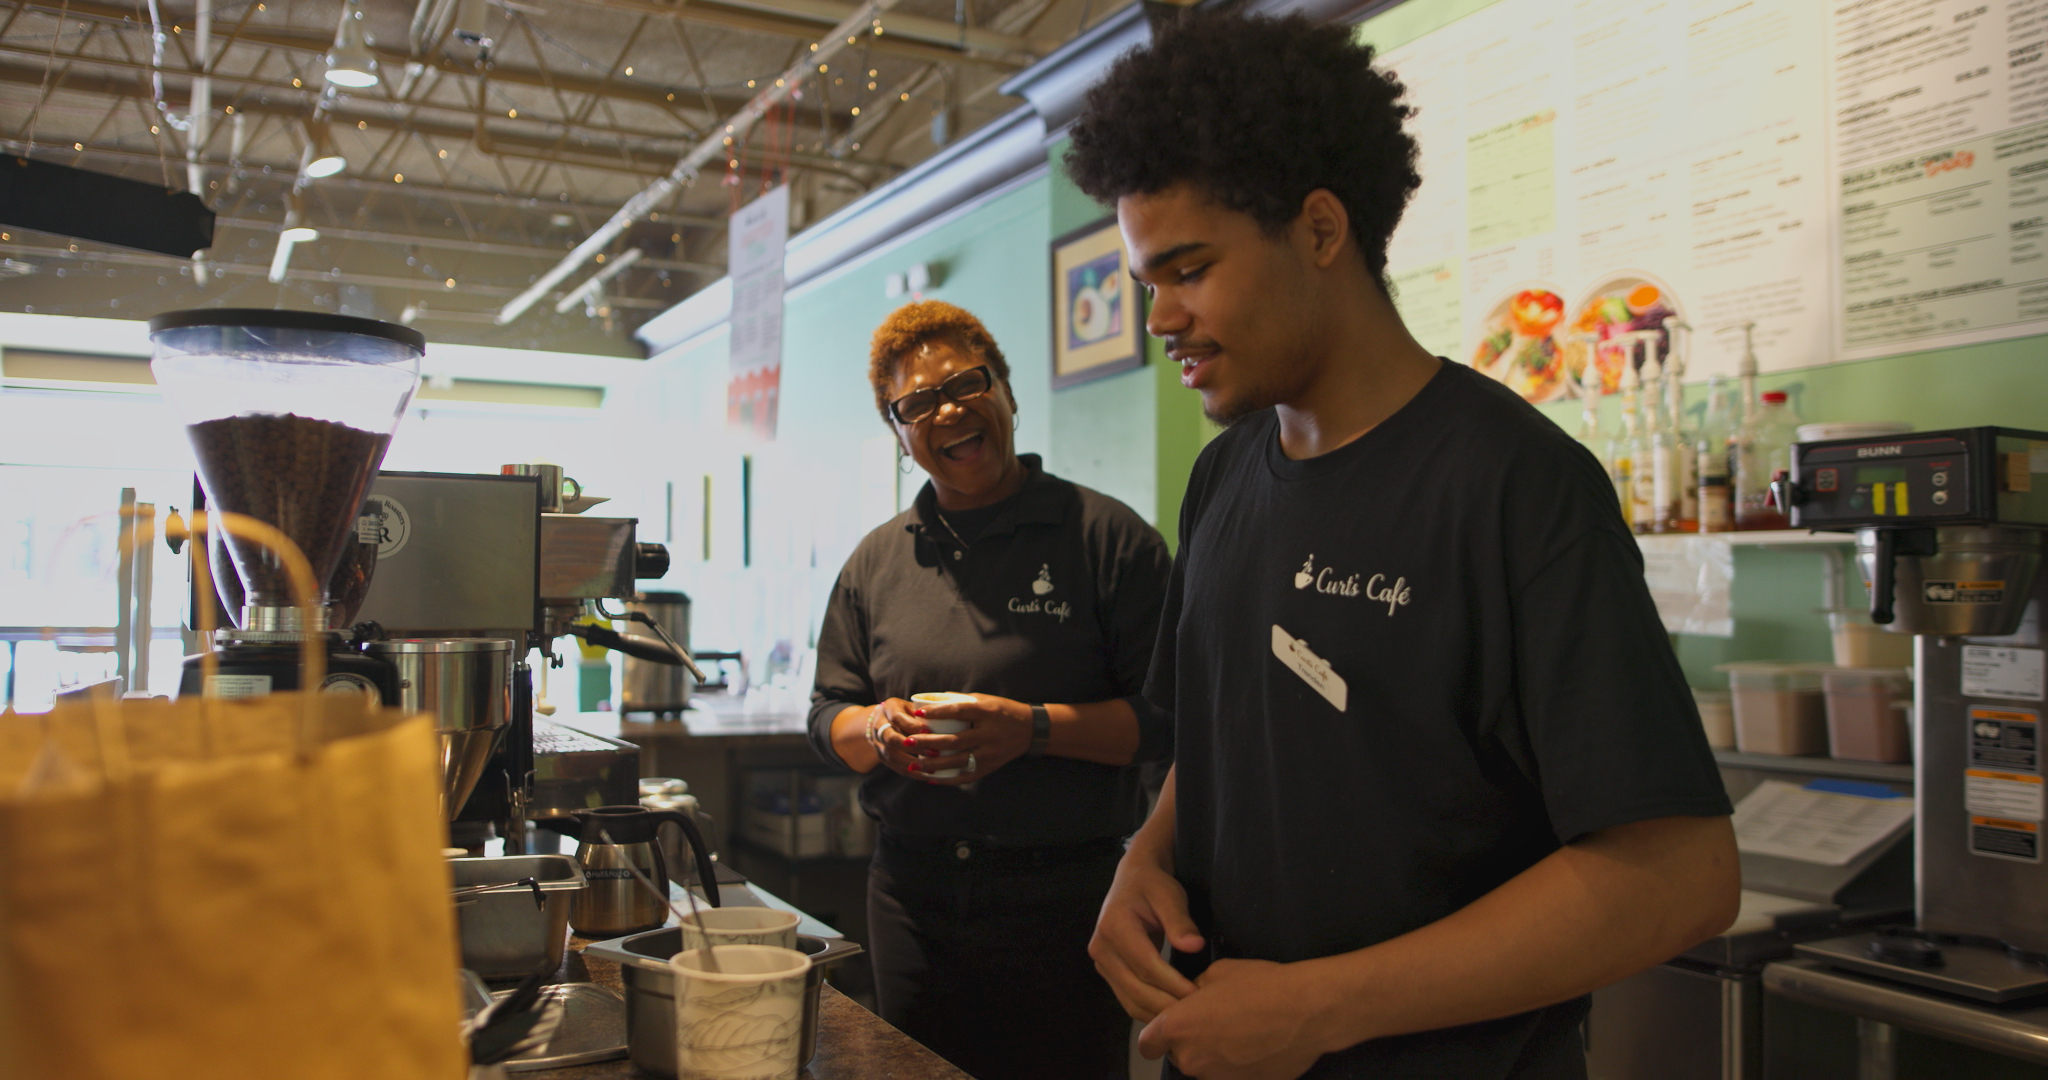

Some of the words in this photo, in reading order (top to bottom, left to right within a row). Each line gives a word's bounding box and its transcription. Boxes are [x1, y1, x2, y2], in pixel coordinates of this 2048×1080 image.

[1842, 170, 1877, 186] BUILD
[1880, 161, 1915, 175] YOUR
[1857, 445, 1902, 457] BUNN
[1316, 566, 1361, 597] Curt's
[1366, 573, 1412, 617] Café
[1008, 597, 1041, 613] Curt's
[1044, 600, 1072, 624] Café
